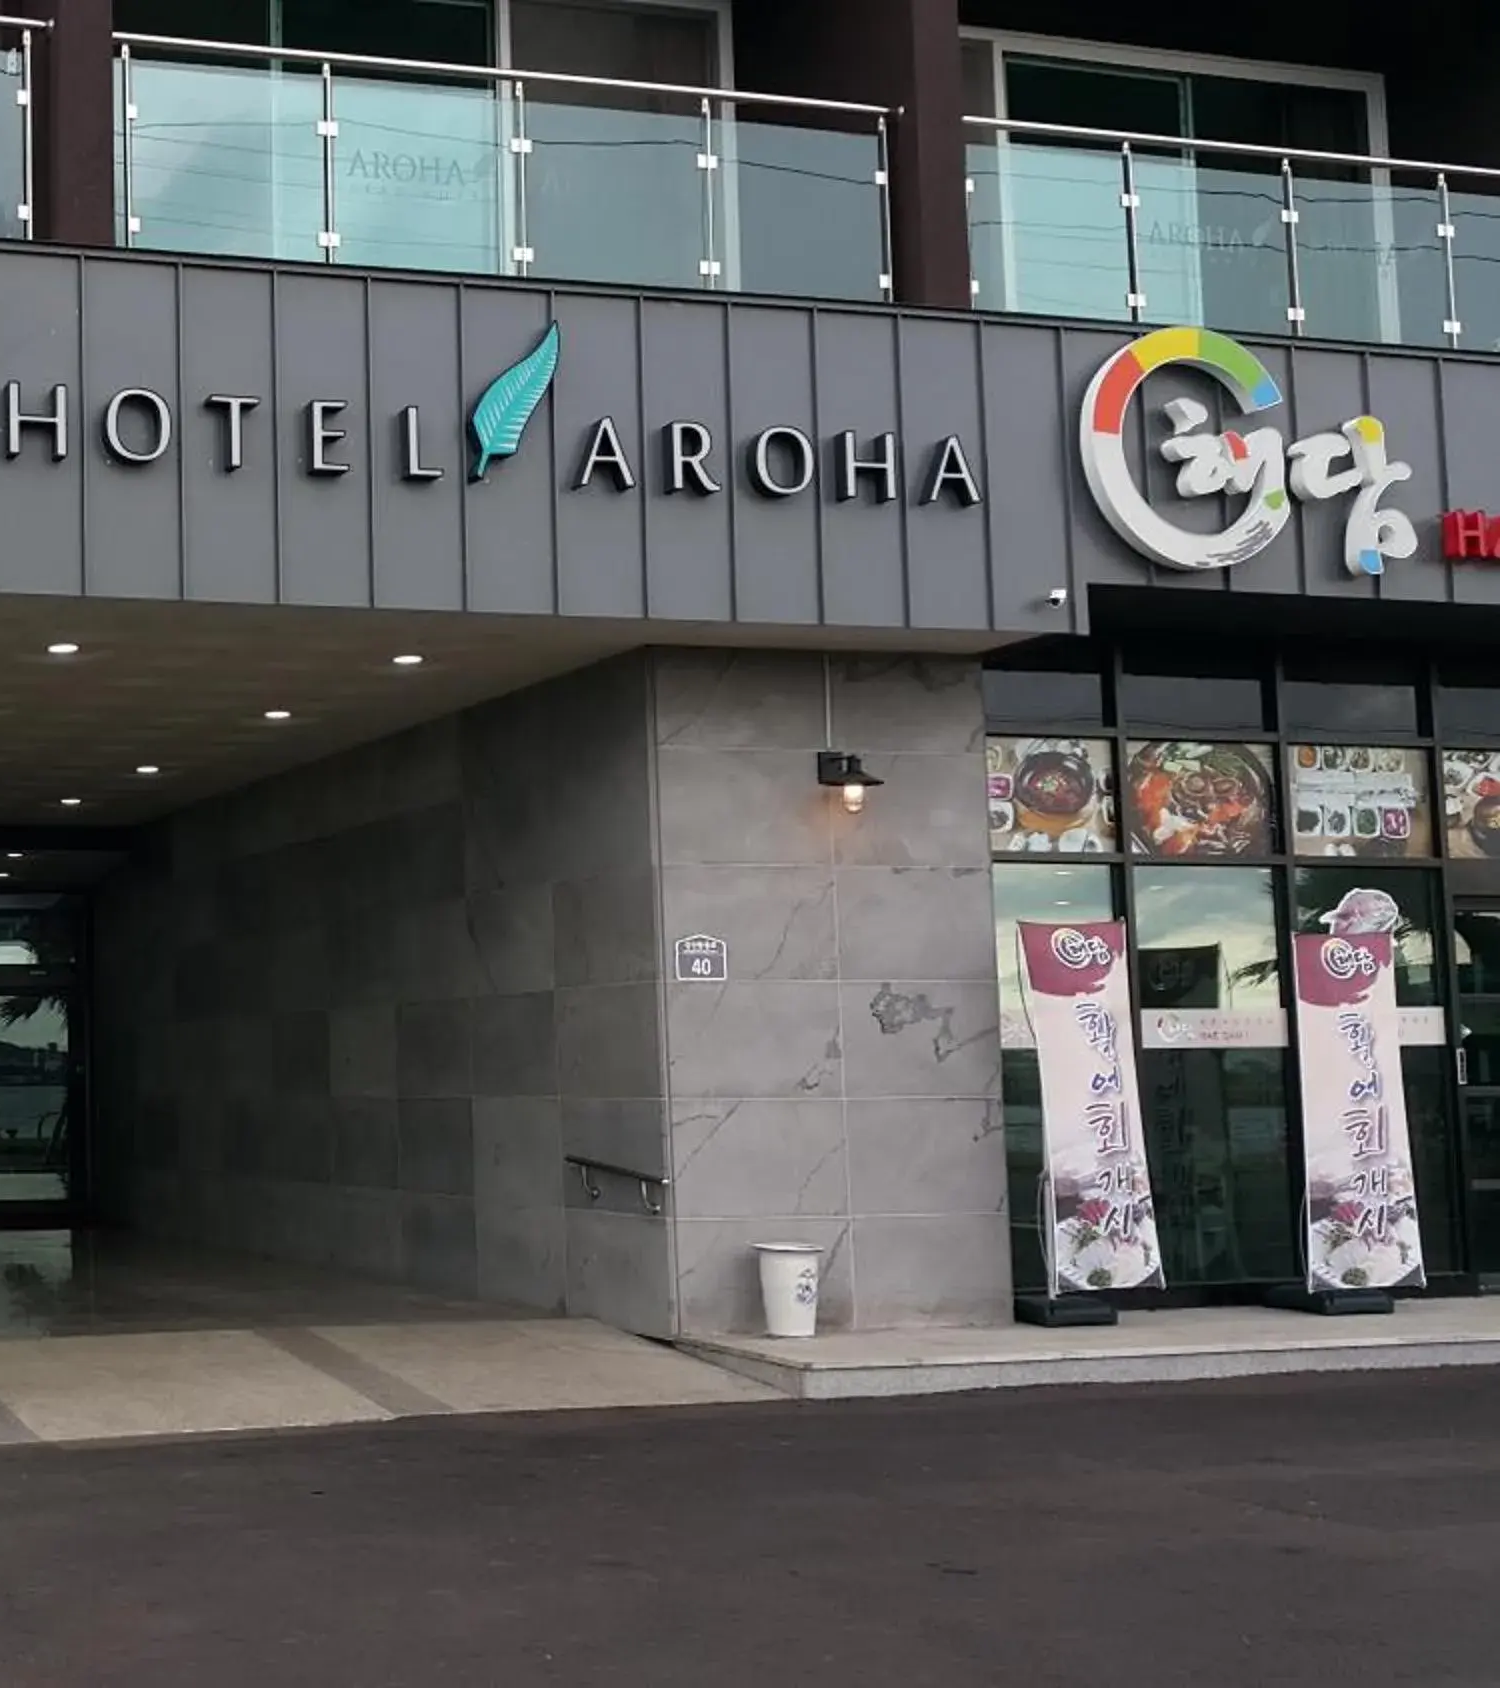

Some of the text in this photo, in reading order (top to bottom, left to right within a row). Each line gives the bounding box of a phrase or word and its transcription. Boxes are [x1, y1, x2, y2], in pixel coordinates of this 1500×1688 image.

[346, 149, 467, 188] AROHA
[4, 379, 983, 506] HOTEL AROHA
[1443, 510, 1500, 560] H
[691, 958, 711, 976] 40
